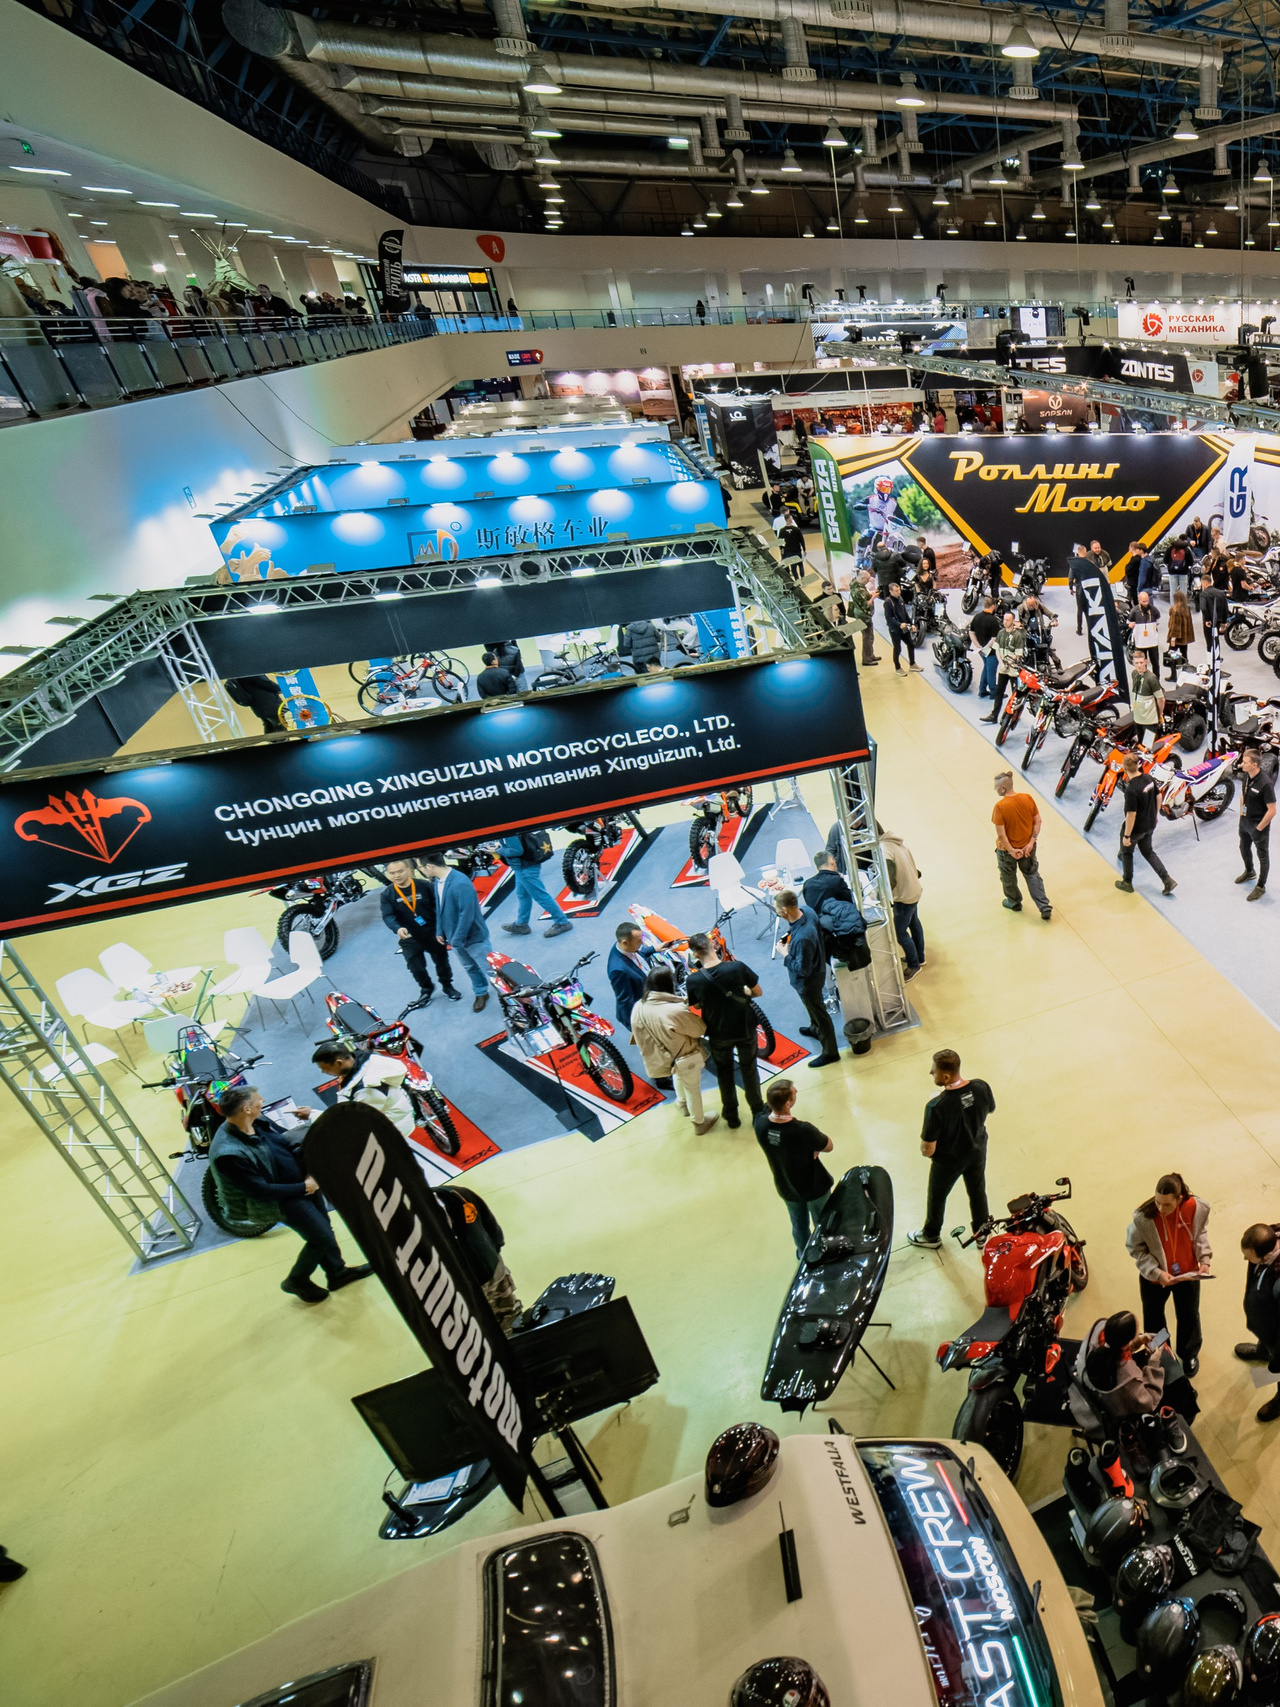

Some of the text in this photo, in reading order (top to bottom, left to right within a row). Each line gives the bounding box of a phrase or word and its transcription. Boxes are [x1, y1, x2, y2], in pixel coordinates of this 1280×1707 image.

[390, 261, 401, 297] ГРИЛЬ
[1168, 314, 1215, 323] РУССКАЯ
[1168, 325, 1226, 333] МЕХАНИКА
[1120, 359, 1174, 383] ZONTES
[949, 451, 1121, 481] Роллинг
[814, 459, 841, 543] GROZA
[1014, 483, 1160, 514] Мото
[214, 714, 736, 822] CHONGQING XINGUIZUN MOTORCYCLECO., LTD.
[224, 735, 742, 847] Чунцин мотоциклетная компания Xinguizun, Ltd.
[44, 862, 189, 905] XGZ
[824, 1440, 867, 1526] WESTFALIA
[893, 1454, 975, 1579] CREW
[968, 1536, 1015, 1620] MOSCOW
